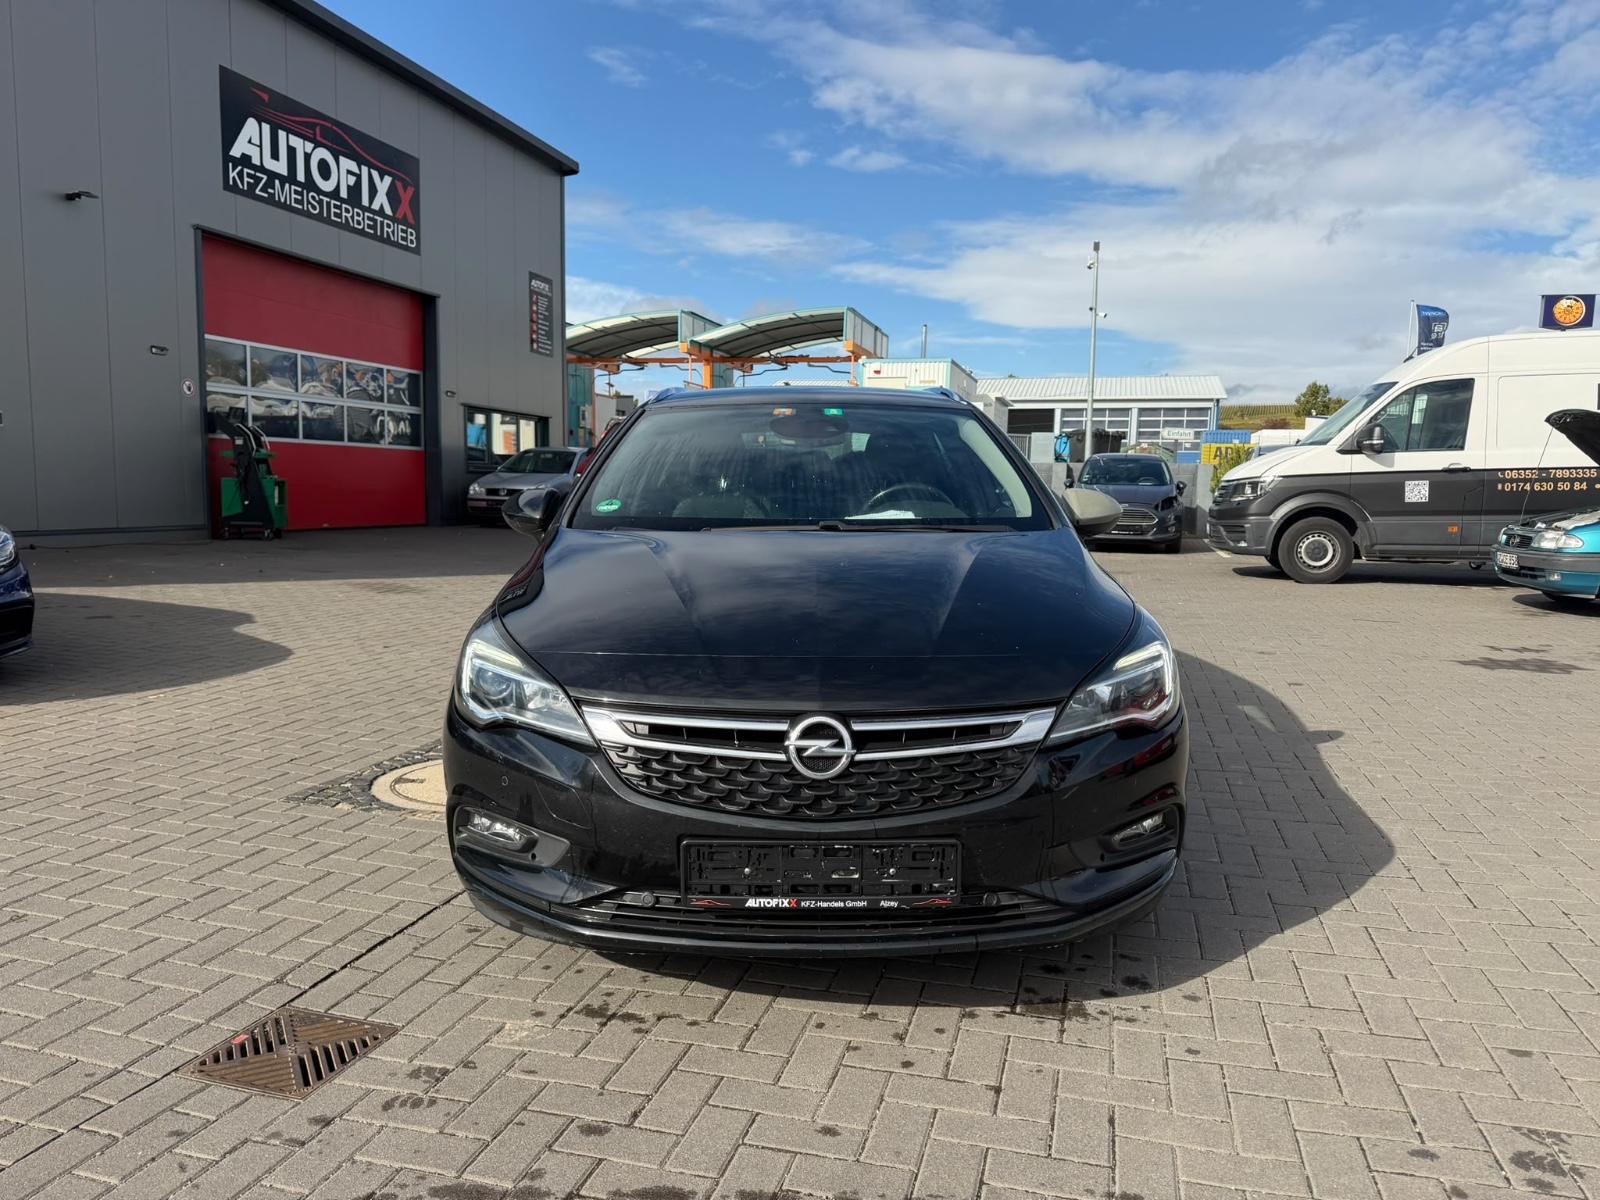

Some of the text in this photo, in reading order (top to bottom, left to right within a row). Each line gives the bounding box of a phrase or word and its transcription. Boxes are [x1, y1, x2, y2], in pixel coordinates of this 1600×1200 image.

[229, 117, 416, 225] AUTOFIXX
[228, 162, 417, 248] KFZ-MEISTERBETRIEB
[1167, 430, 1191, 438] Einfahrt
[1505, 470, 1538, 479] 06352
[1549, 468, 1597, 479] 7893335
[1504, 482, 1587, 491] 0174 630 50 84
[745, 899, 898, 908] AUTOFIXX KFZ-Handels GmbH Alzey
